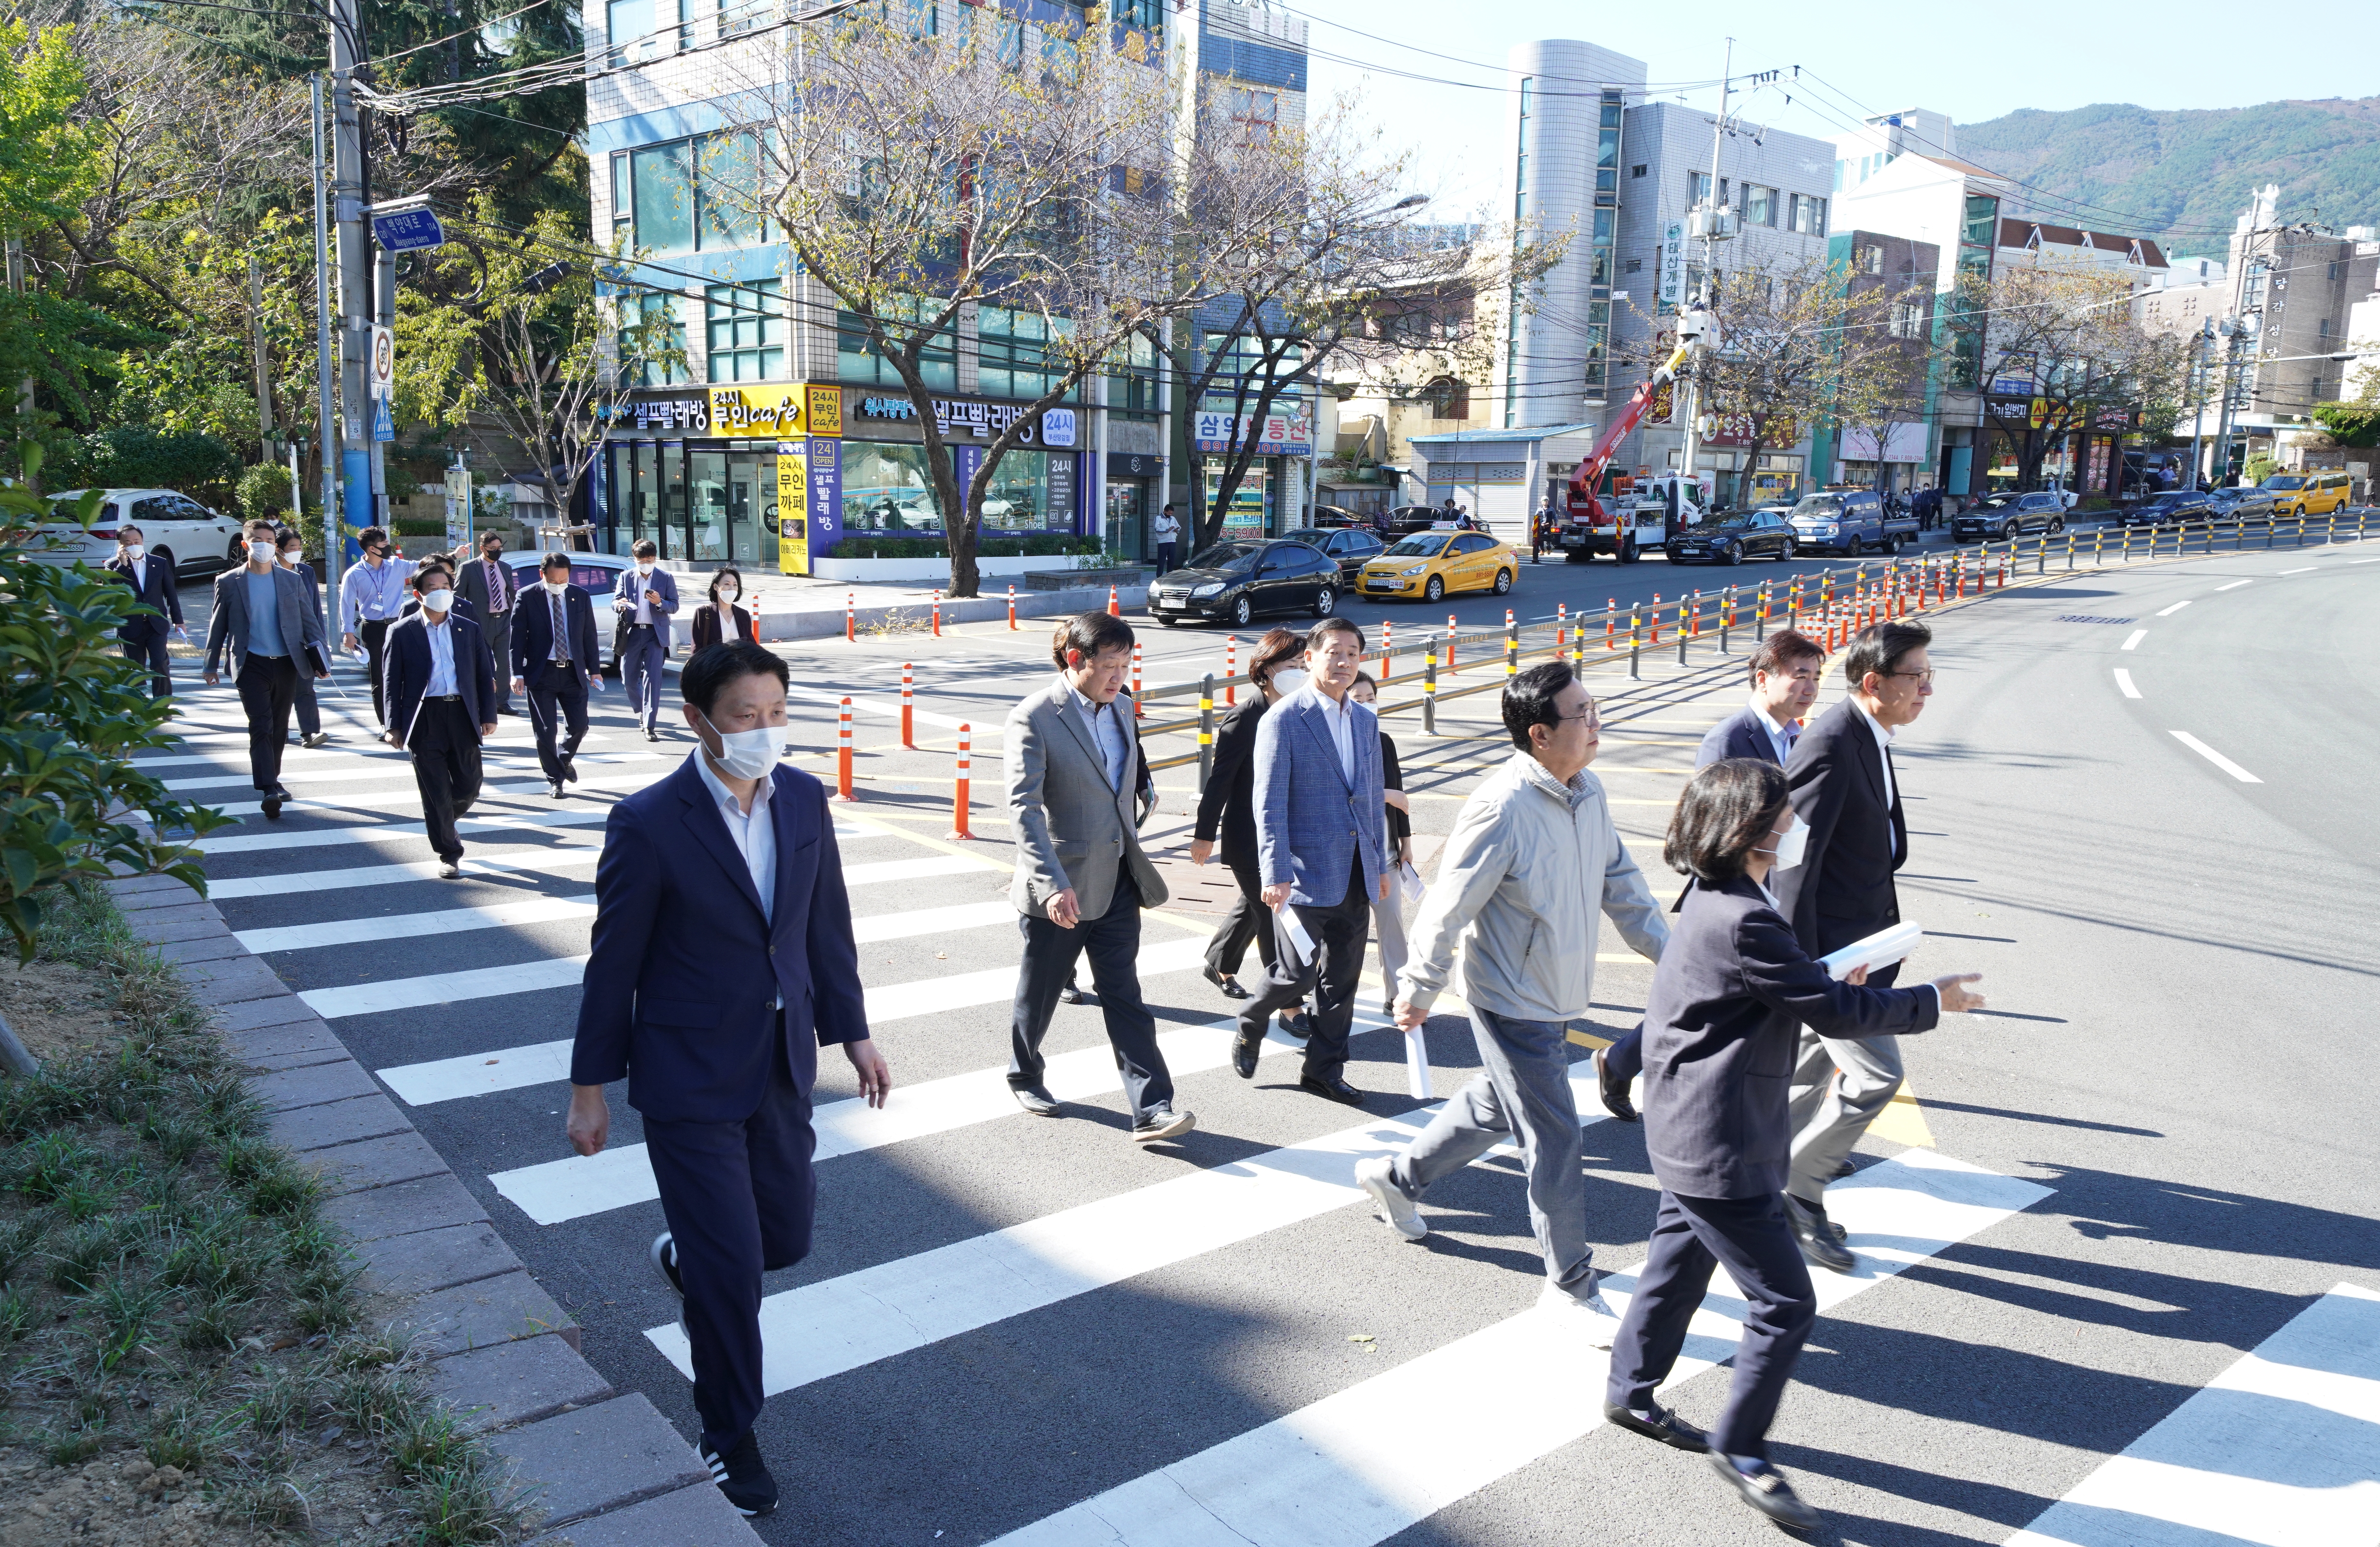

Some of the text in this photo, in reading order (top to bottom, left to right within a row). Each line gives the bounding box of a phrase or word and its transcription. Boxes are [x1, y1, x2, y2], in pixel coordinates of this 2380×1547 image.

[1250, 10, 1302, 42] 부동산
[386, 215, 421, 234] 백양대로
[427, 222, 437, 231] 114
[378, 230, 388, 239] 120
[393, 235, 429, 247] Baegyang-daero
[1666, 242, 1679, 297] 태산개발
[2267, 278, 2287, 359] 당감성당
[712, 390, 739, 405] 24시
[813, 391, 838, 403] 24시
[712, 396, 797, 431] 무인 cafe
[814, 404, 837, 415] 무인
[864, 397, 908, 419] 워시팡팡
[635, 400, 707, 431] 셀프빨래방
[813, 415, 839, 430] cafe
[1046, 413, 1072, 431] 24시
[1048, 434, 1070, 442] 부산당감점
[778, 443, 805, 453] 셀프빨래방
[817, 443, 831, 454] 24
[1201, 440, 1281, 453] 895-00
[780, 462, 801, 470] 24시
[1052, 460, 1071, 472] 24시
[780, 474, 803, 490] 무인
[814, 475, 834, 486] 셀프
[781, 495, 804, 511] 까페
[816, 487, 833, 531] 빨래방
[1025, 519, 1044, 529] Shoes
[1218, 527, 1261, 539] 5-5900
[781, 544, 807, 555] 아메리카노
[1460, 633, 1488, 644] 무단횡단금지
[1367, 648, 1401, 660] 무단횡단금지
